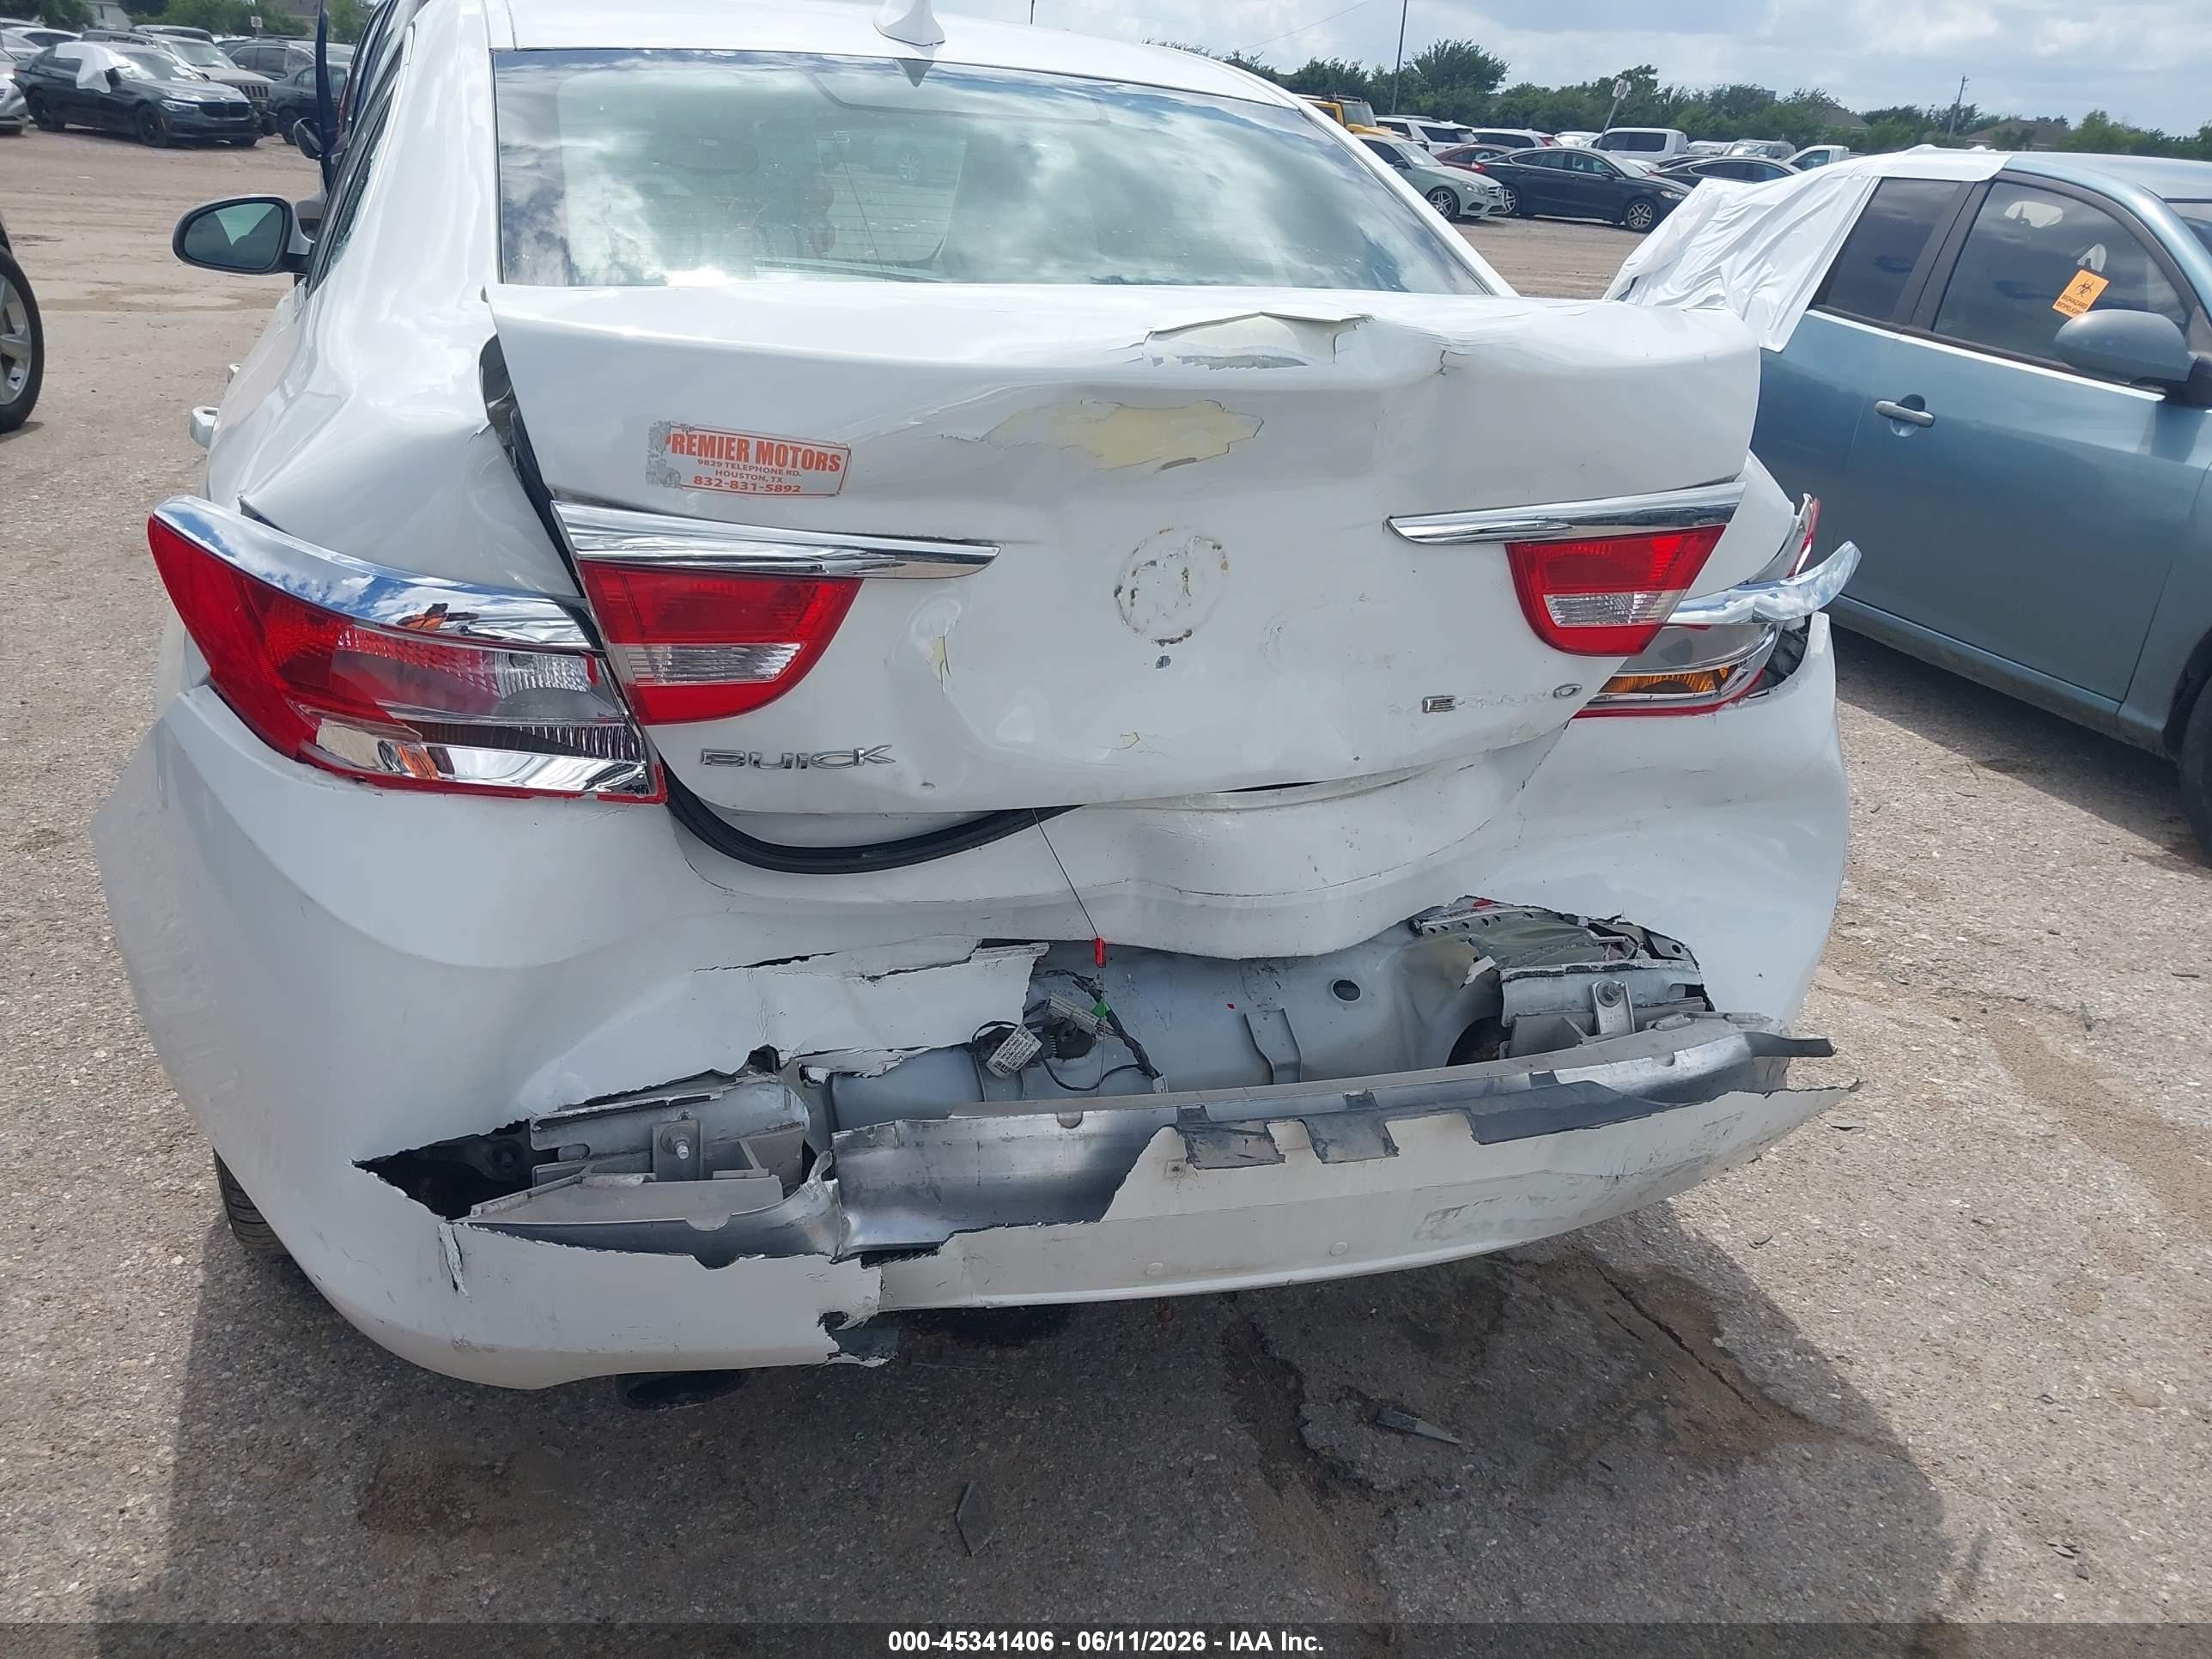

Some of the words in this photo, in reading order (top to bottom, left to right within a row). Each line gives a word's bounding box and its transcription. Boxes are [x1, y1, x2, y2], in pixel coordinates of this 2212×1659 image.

[755, 441, 841, 471] MOTORS
[697, 459, 723, 468] 9829
[725, 462, 783, 476] TELEPHONE
[714, 470, 769, 482] HOUSTON,
[693, 476, 800, 493] 832-831-5892
[701, 744, 896, 770] BUICK
